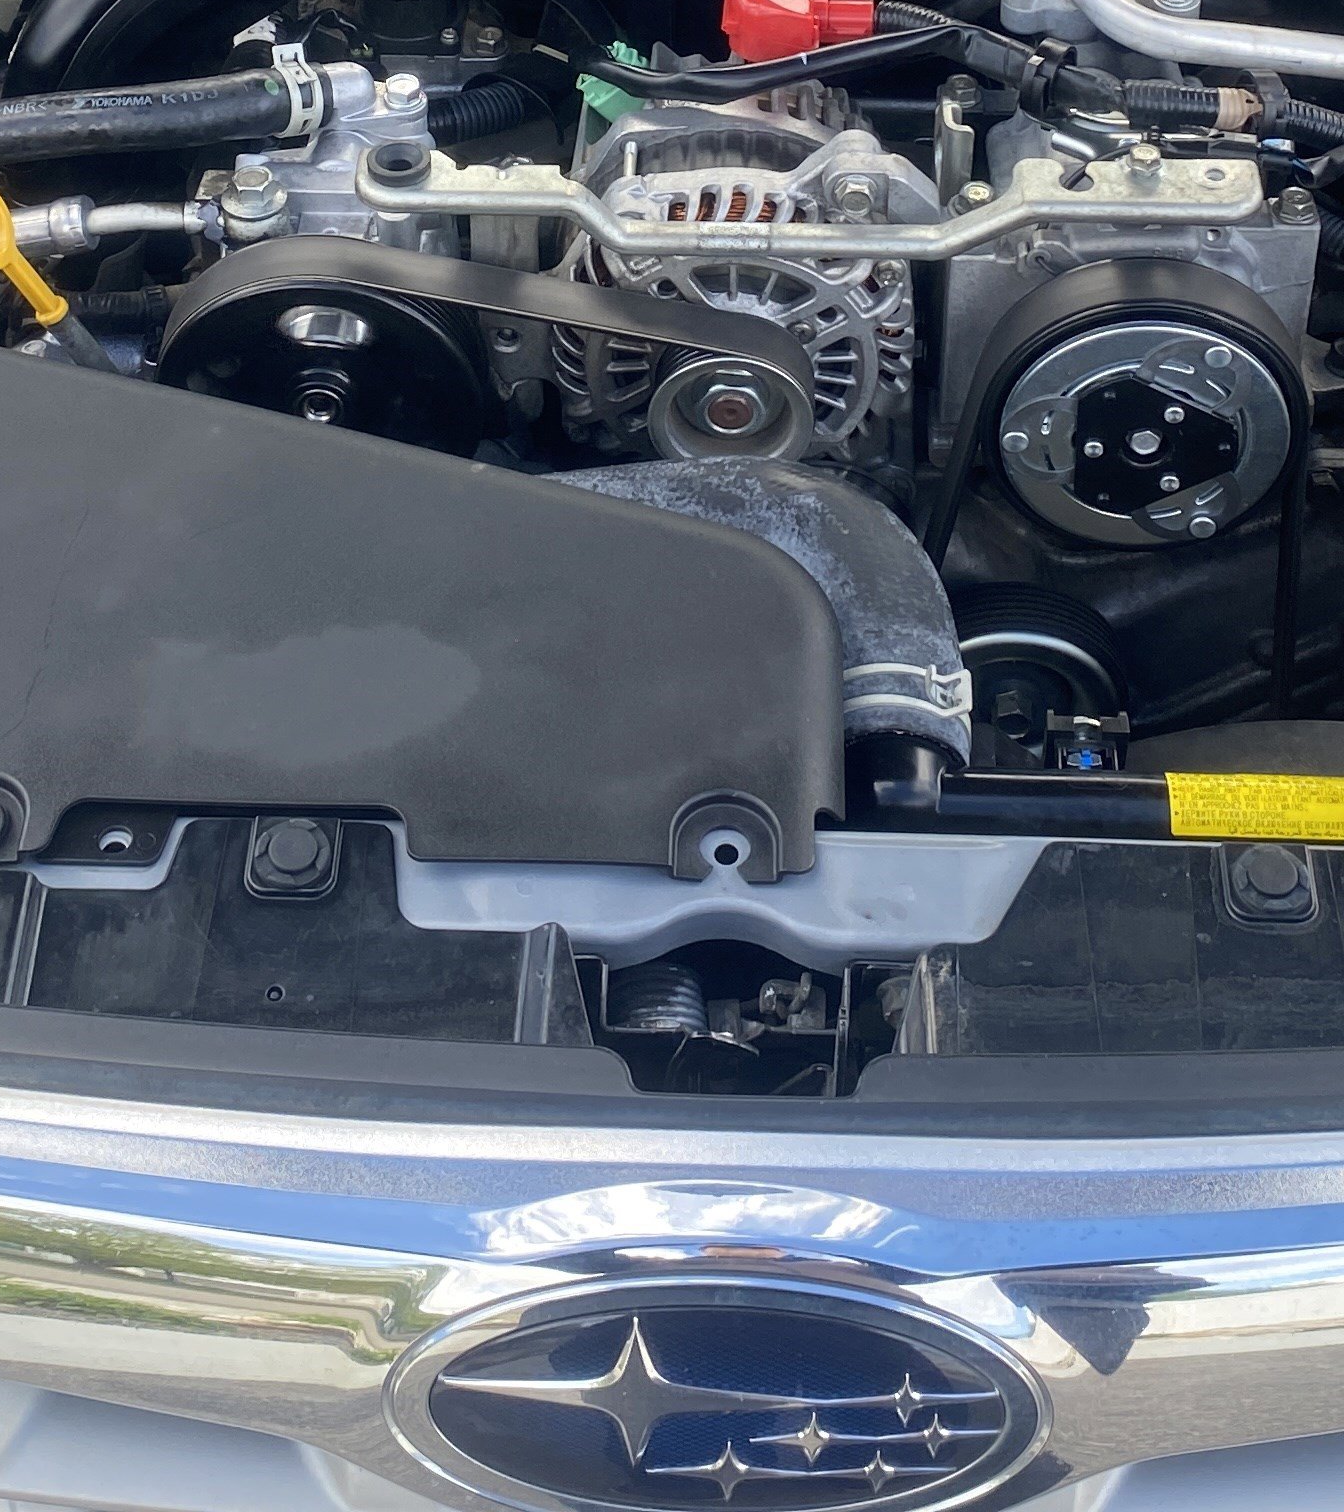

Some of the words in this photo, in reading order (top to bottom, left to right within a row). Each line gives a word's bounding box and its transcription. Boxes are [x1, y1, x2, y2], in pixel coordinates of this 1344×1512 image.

[90, 94, 153, 109] YOKOHAMA
[1202, 801, 1242, 809] APPROCHEZ
[1245, 802, 1260, 810] PAS
[1218, 810, 1240, 818] РУКИ
